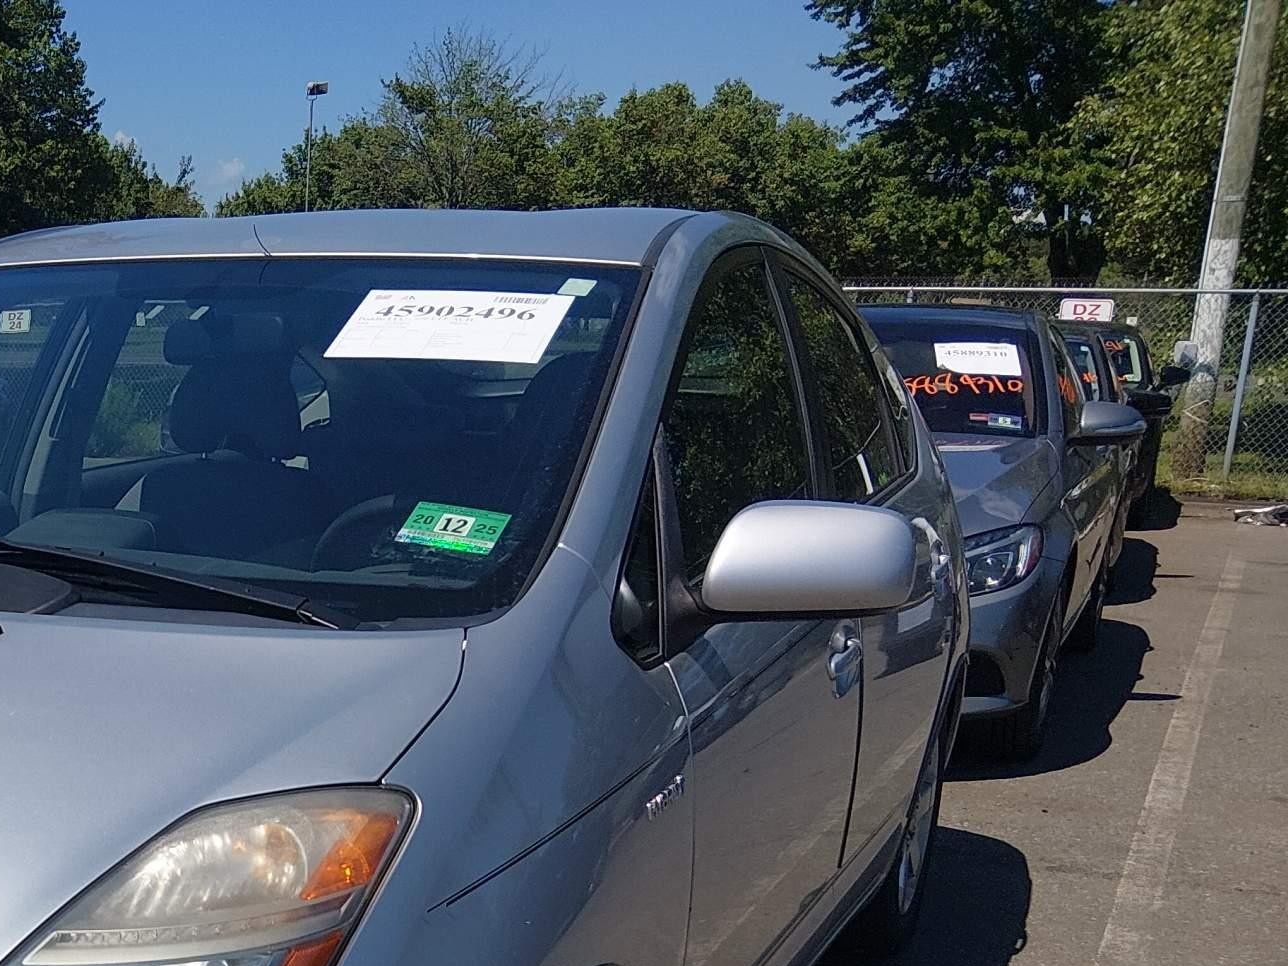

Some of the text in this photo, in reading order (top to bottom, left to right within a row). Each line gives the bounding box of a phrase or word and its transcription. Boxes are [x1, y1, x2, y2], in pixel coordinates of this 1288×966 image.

[8, 312, 24, 320] DZ
[375, 304, 538, 321] 45902496
[1073, 303, 1102, 316] DZ
[9, 321, 22, 330] 24
[412, 513, 500, 535] 20 12 25
